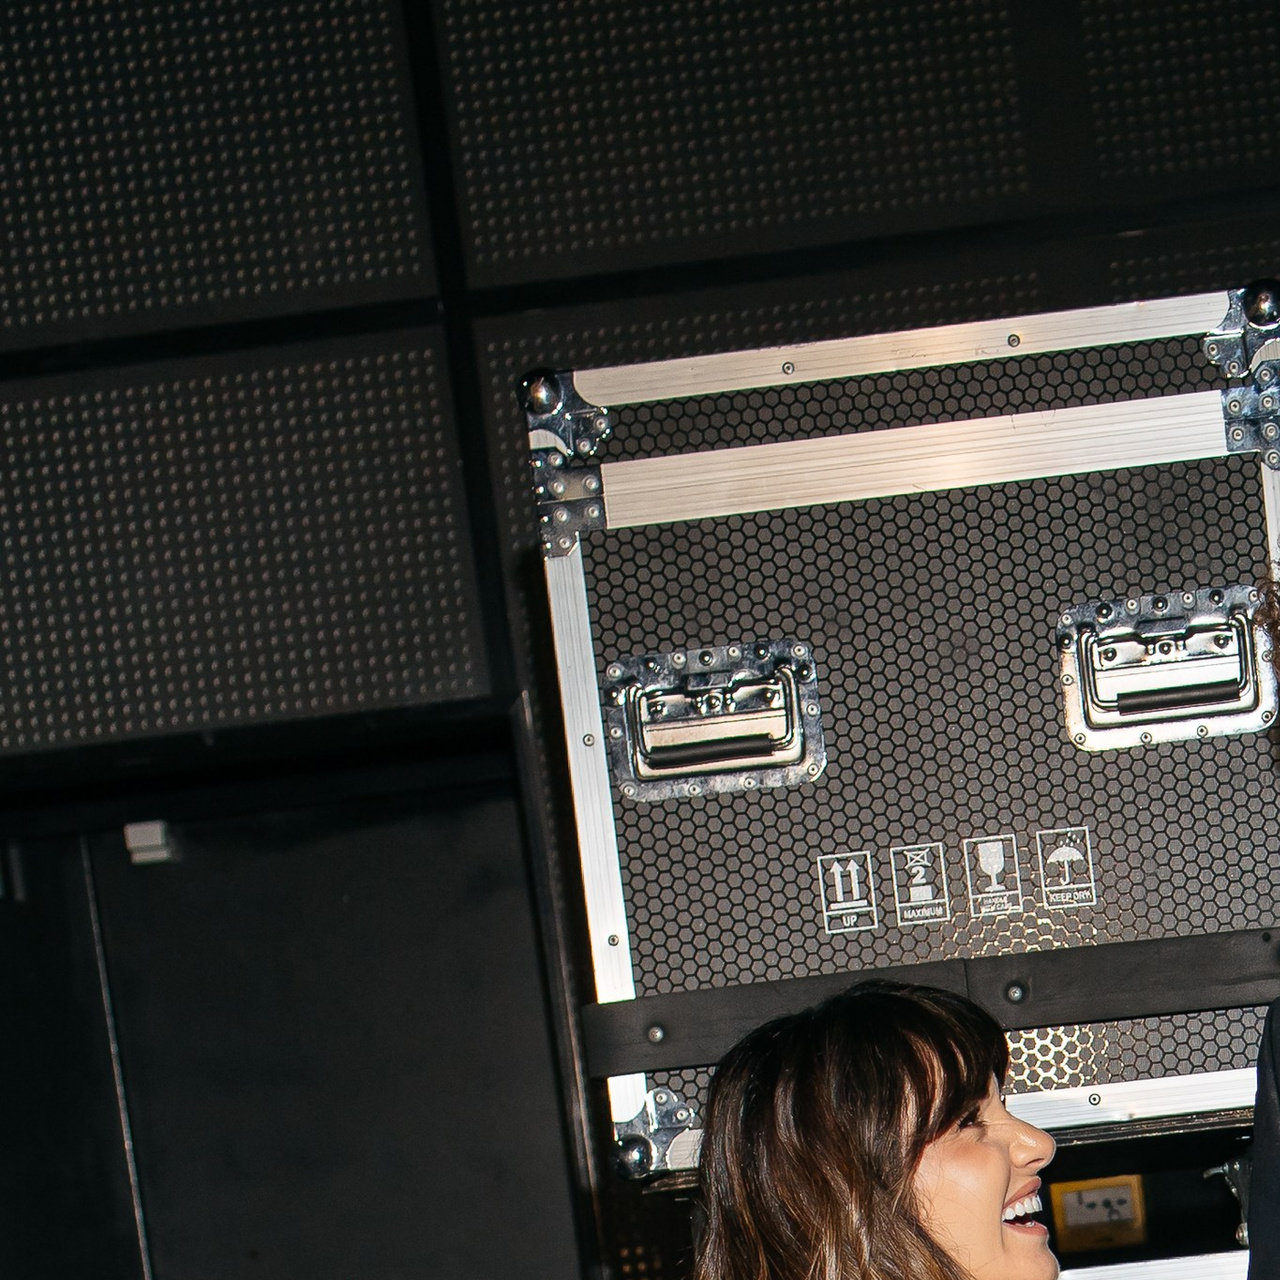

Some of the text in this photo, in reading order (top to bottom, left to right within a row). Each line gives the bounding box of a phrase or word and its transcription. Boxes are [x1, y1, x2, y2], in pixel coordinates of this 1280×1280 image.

[911, 866, 926, 884] 2
[1050, 890, 1091, 903] KEEP DRY
[903, 906, 943, 919] MAXIMUM
[842, 915, 857, 927] UP
